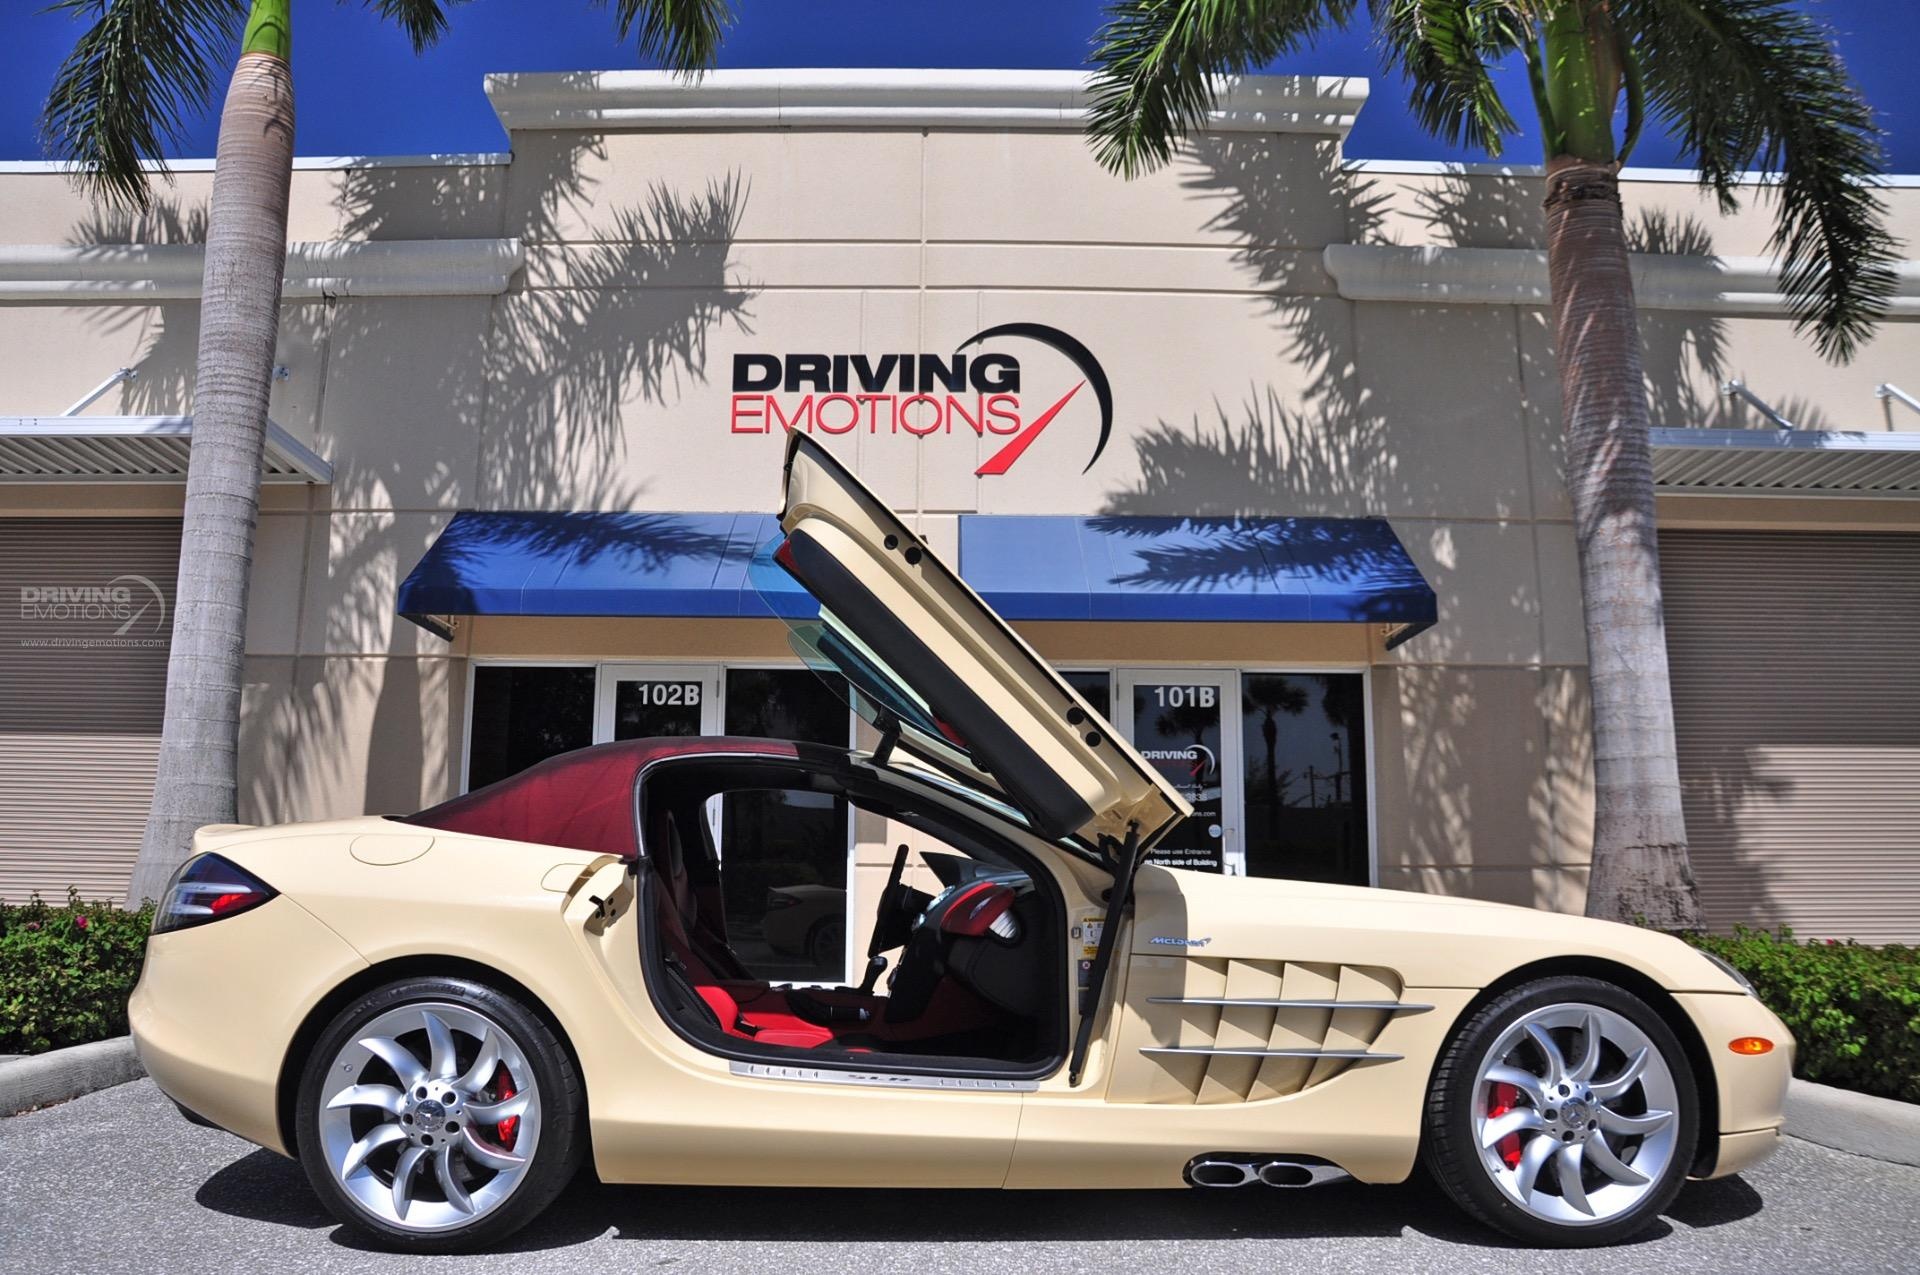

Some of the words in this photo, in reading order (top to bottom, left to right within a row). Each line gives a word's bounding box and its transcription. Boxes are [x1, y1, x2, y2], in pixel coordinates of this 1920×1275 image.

[732, 353, 1020, 394] DRIVING
[731, 394, 1021, 434] EMOTIONS
[638, 683, 700, 706] 102B
[1154, 686, 1215, 708] 101B
[1141, 750, 1198, 760] DRIVING
[1153, 858, 1171, 866] North
[1172, 858, 1185, 866] side
[1185, 858, 1193, 866] of
[1193, 858, 1218, 867] Building
